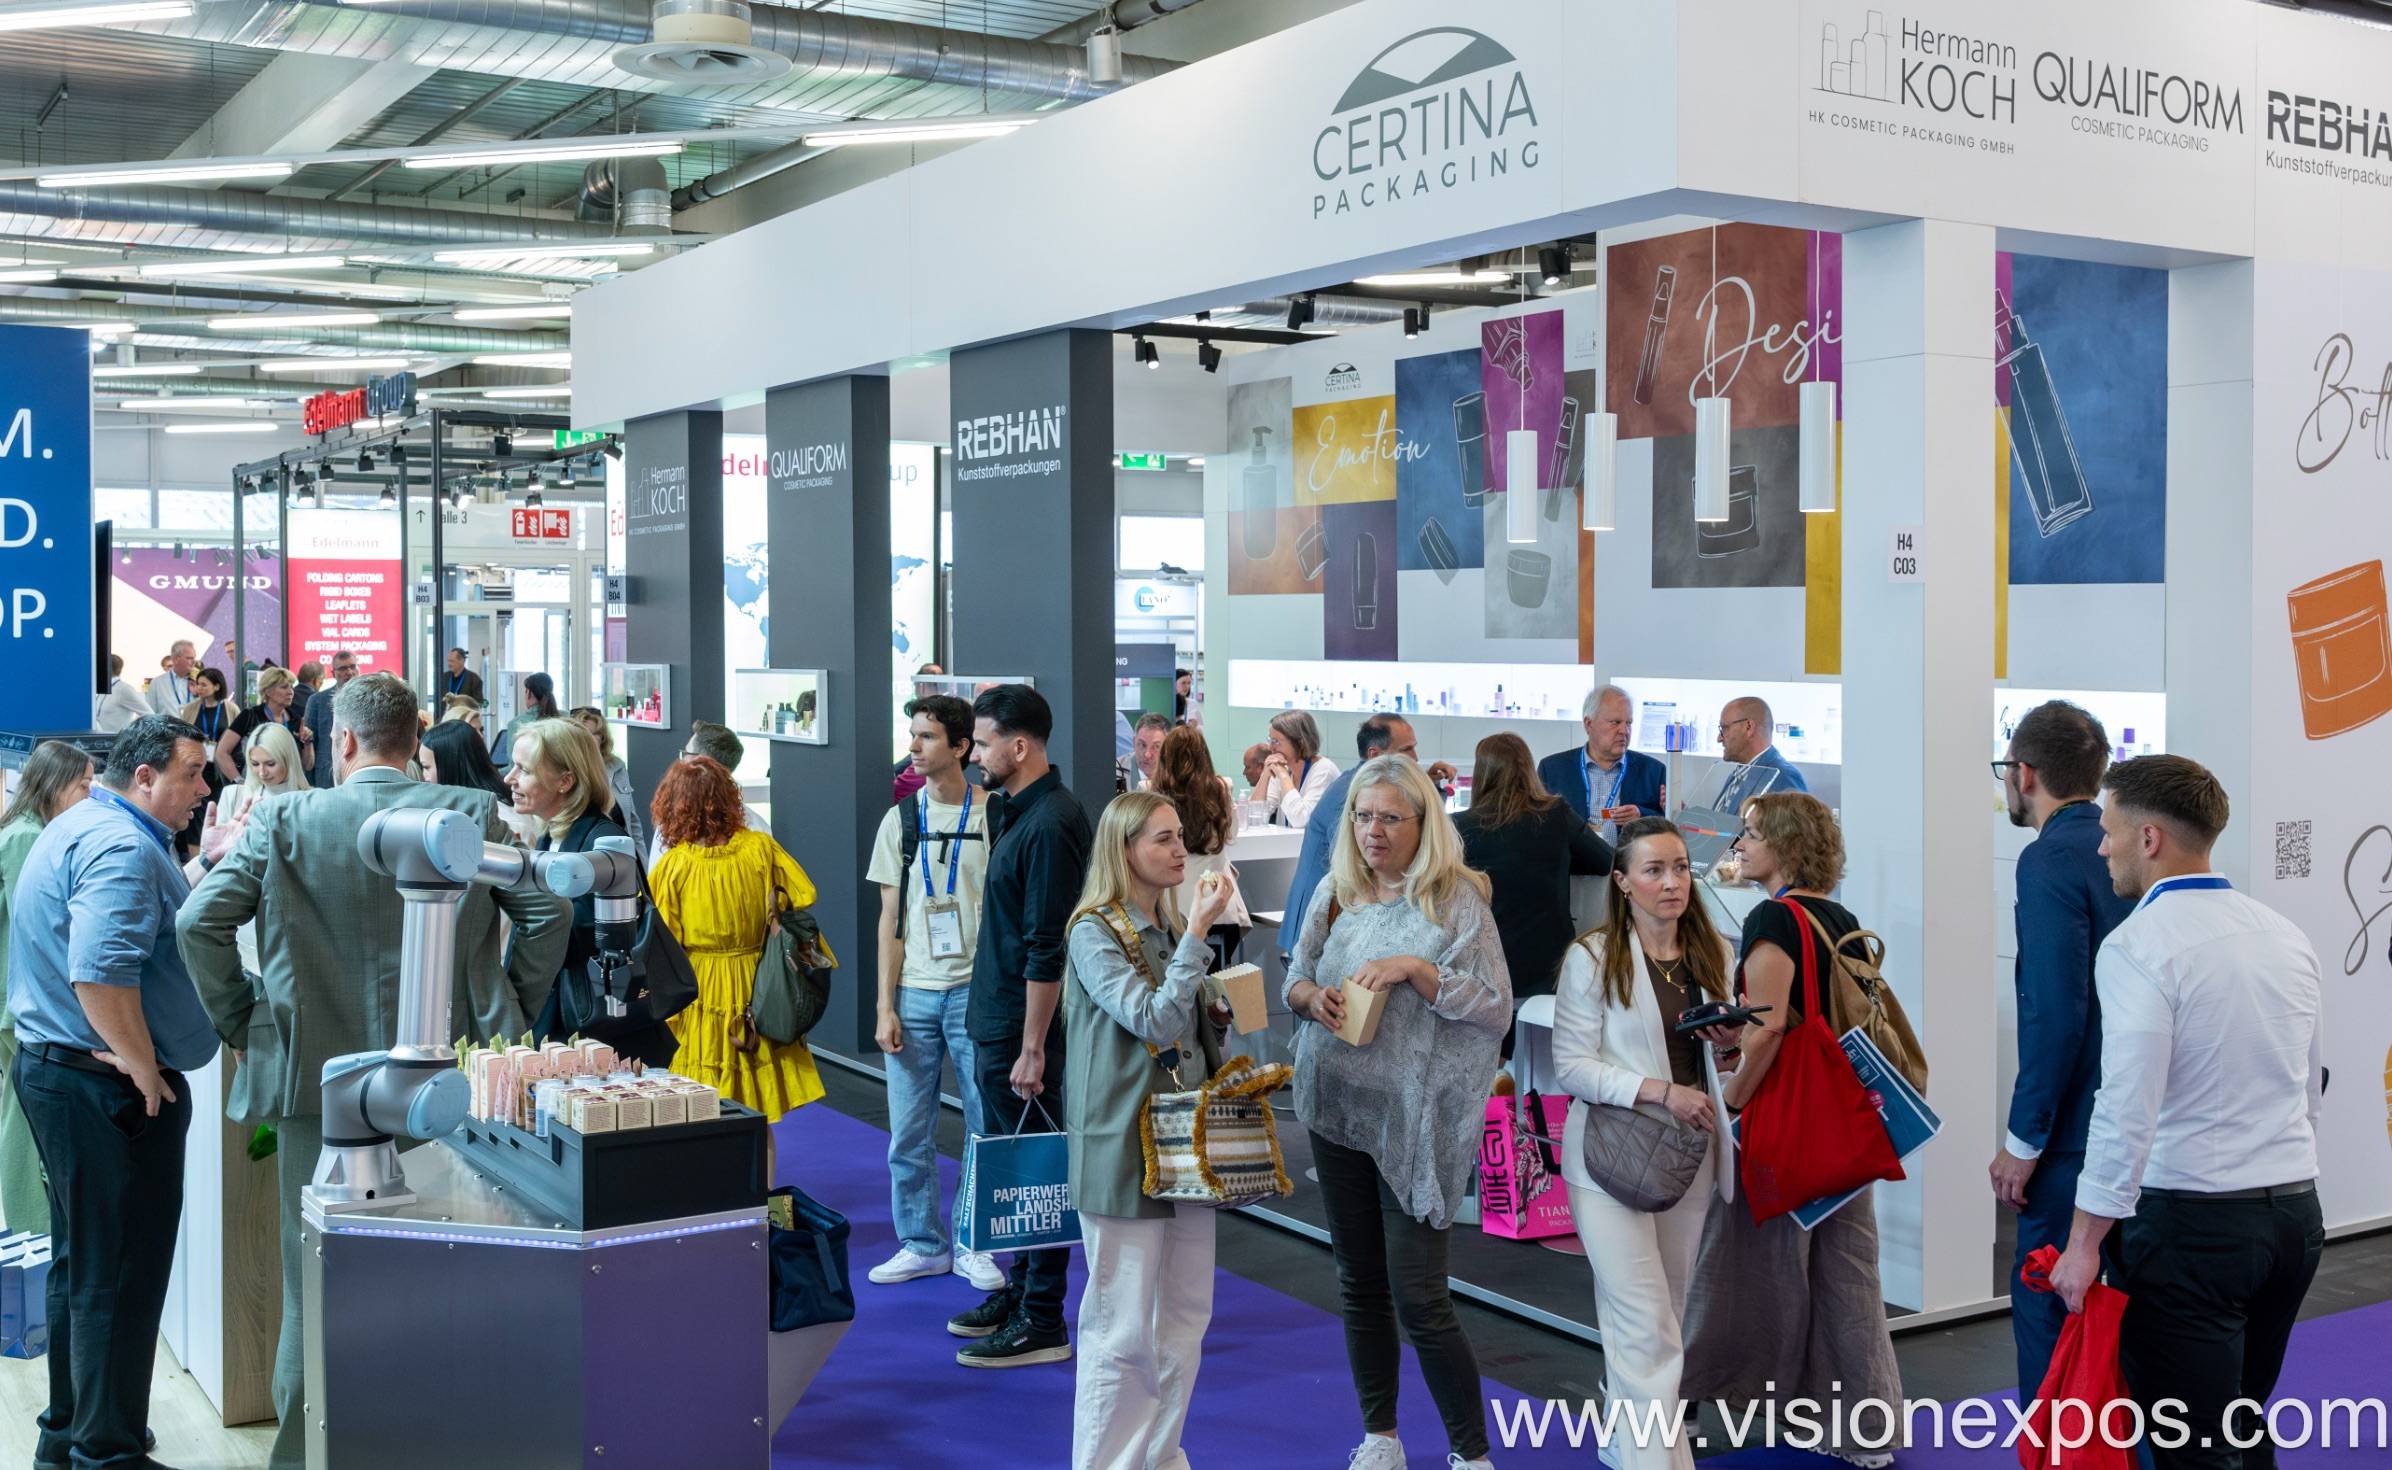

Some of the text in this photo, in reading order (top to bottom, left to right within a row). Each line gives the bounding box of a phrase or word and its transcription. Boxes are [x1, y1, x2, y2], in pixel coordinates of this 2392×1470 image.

[1902, 17, 2016, 70] Hermann
[1901, 58, 2015, 124] KOCH
[2033, 51, 2244, 135] QUALIFORM
[1313, 71, 1538, 181] CERTINA
[1809, 110, 2014, 154] HK COSMETIC PACKAGING GMBH
[2071, 115, 2209, 152] COSMETIC PACKAGING
[1314, 141, 1539, 219] PACKAGING
[1325, 372, 1361, 387] CERTINA
[304, 371, 411, 436] Edelmann Group
[1309, 408, 1430, 492] Emotion
[771, 442, 848, 479] QUALIFORM
[651, 466, 685, 485] Hermann
[958, 460, 1061, 482] Kunststoffverpackungen
[651, 485, 686, 516] KOCH
[442, 511, 468, 524] alle 3
[1897, 533, 1913, 551] H4
[1893, 557, 1916, 575] C03
[149, 575, 272, 590] GMUND
[307, 572, 384, 583] FOLDING CARTONS
[609, 579, 619, 589] H4
[343, 586, 372, 597] BOXES
[418, 585, 428, 594] H4
[325, 600, 367, 610] LEAFLETS
[415, 595, 430, 604] B03
[0, 588, 54, 639] P.
[320, 613, 372, 624] WET LABELS
[322, 627, 370, 638] VIAL CARDS
[305, 640, 387, 651] SYSTEM PACKAGING
[1016, 1198, 1078, 1216] LANDSH
[990, 1212, 1062, 1236] MITTLER
